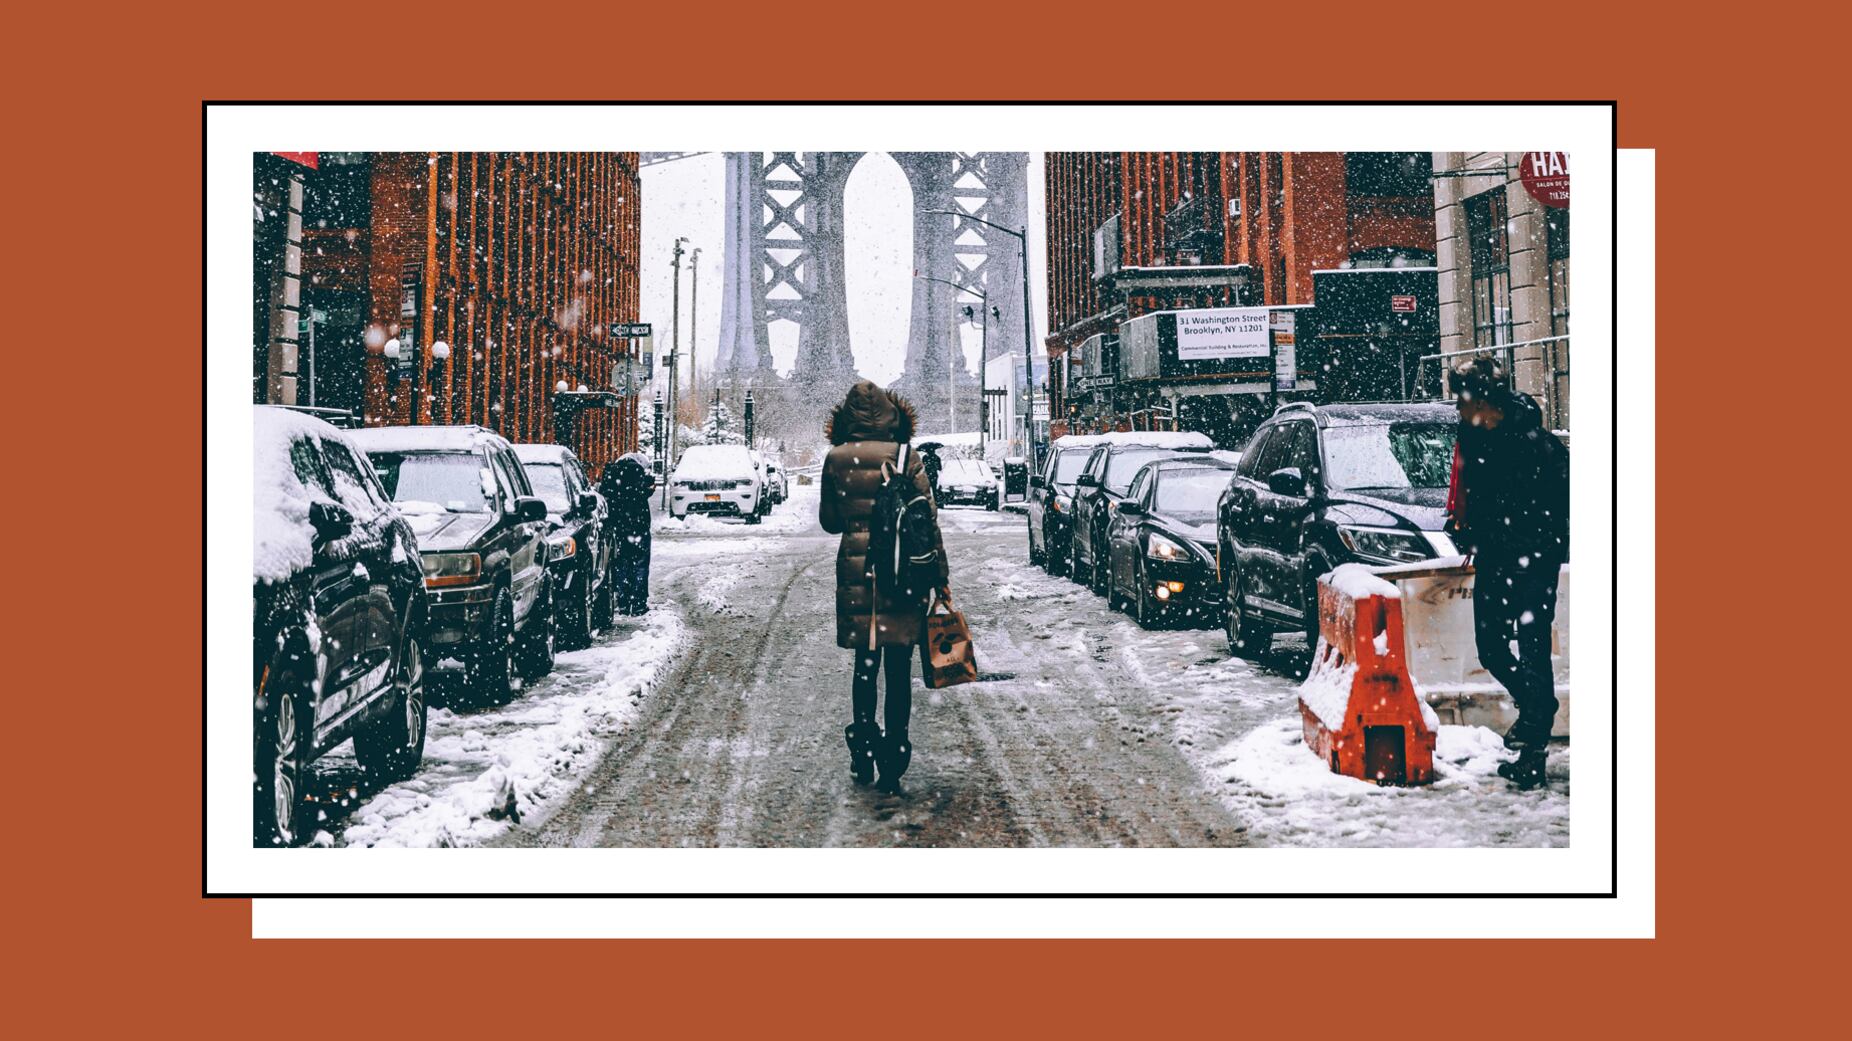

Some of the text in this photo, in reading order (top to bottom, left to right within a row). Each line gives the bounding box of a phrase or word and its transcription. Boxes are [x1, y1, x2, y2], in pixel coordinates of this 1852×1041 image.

[1180, 314, 1267, 326] 31 Washington Street
[1184, 326, 1223, 335] Brooklyn,
[1239, 324, 1263, 332] 11201
[1079, 379, 1094, 387] ONE
[1032, 404, 1050, 414] PARK
